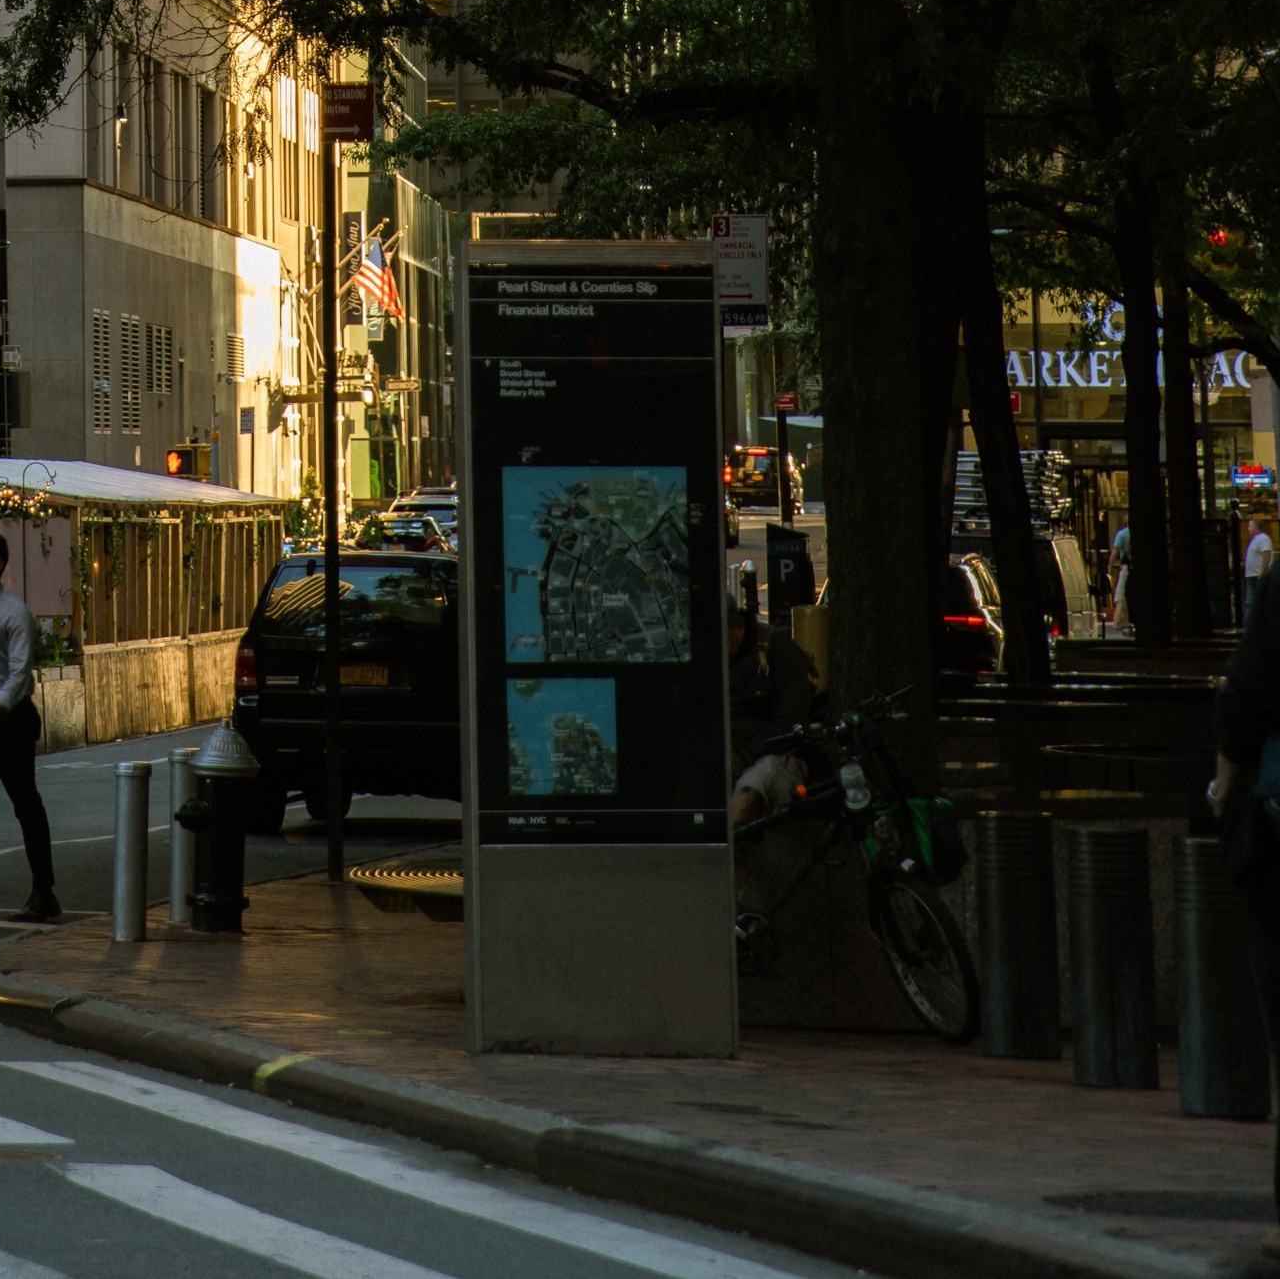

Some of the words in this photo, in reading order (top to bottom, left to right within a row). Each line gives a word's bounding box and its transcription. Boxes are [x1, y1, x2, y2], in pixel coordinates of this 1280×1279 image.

[323, 89, 333, 100] NO
[333, 88, 367, 100] STANDING
[323, 103, 350, 116] Anytime
[717, 218, 727, 236] 3
[719, 242, 757, 250] OMMERCIAL
[746, 251, 763, 259] ONLY
[498, 280, 528, 293] Pearl
[531, 280, 567, 293] Street
[569, 281, 579, 293] &
[581, 280, 634, 293] Coenties
[636, 281, 658, 295] Slip
[498, 303, 549, 316] Financial
[552, 303, 594, 316] District
[499, 360, 522, 368] South
[499, 369, 522, 377] Broad
[523, 369, 546, 378] Street
[499, 379, 533, 387] Whitehall
[534, 379, 557, 387] Street
[500, 388, 527, 398] Battery
[528, 388, 545, 396] Park
[779, 559, 795, 582] P
[508, 816, 526, 824] Walk
[529, 816, 547, 824] NYC
